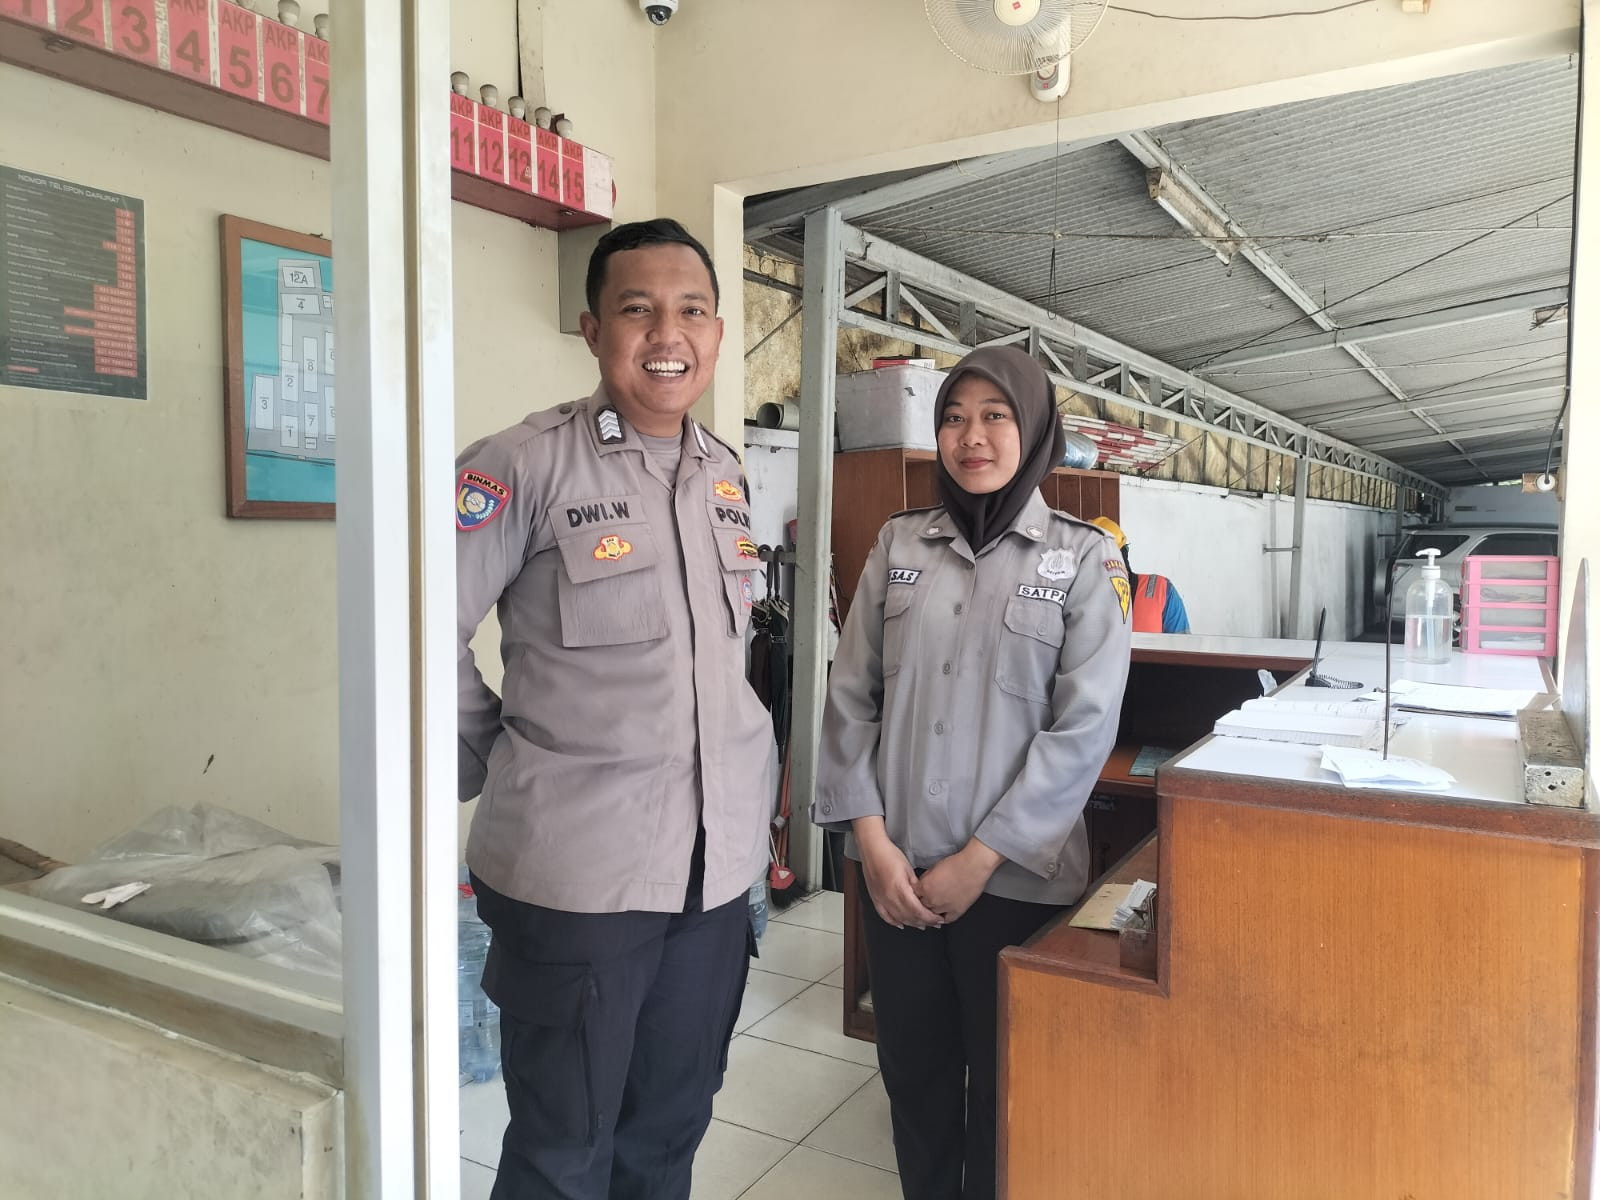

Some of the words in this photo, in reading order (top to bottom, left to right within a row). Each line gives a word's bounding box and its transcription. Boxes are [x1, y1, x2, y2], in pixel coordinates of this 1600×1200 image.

[64, 0, 95, 37] 2
[121, 5, 150, 54] 3
[221, 7, 255, 37] AKP
[176, 29, 205, 73] 4
[265, 23, 298, 51] AKP
[228, 44, 253, 89] 5
[271, 61, 294, 103] 6
[312, 75, 329, 115] 7
[480, 109, 503, 129] AKP
[510, 119, 531, 138] AKP
[451, 127, 474, 167] 11
[538, 132, 558, 151] AKP
[564, 141, 583, 158] AKP
[480, 137, 503, 175] 12
[18, 174, 47, 186] NOMOR
[48, 181, 84, 196] TELEPON
[85, 189, 120, 203] DARURAT
[538, 159, 560, 196] 14
[563, 168, 584, 203] 15
[297, 300, 304, 310] 4
[307, 361, 314, 372] 8
[287, 377, 294, 387] 2
[261, 399, 268, 410] 3
[308, 417, 315, 426] 7
[467, 473, 506, 496] BINMAS
[566, 501, 631, 529] DWI.W
